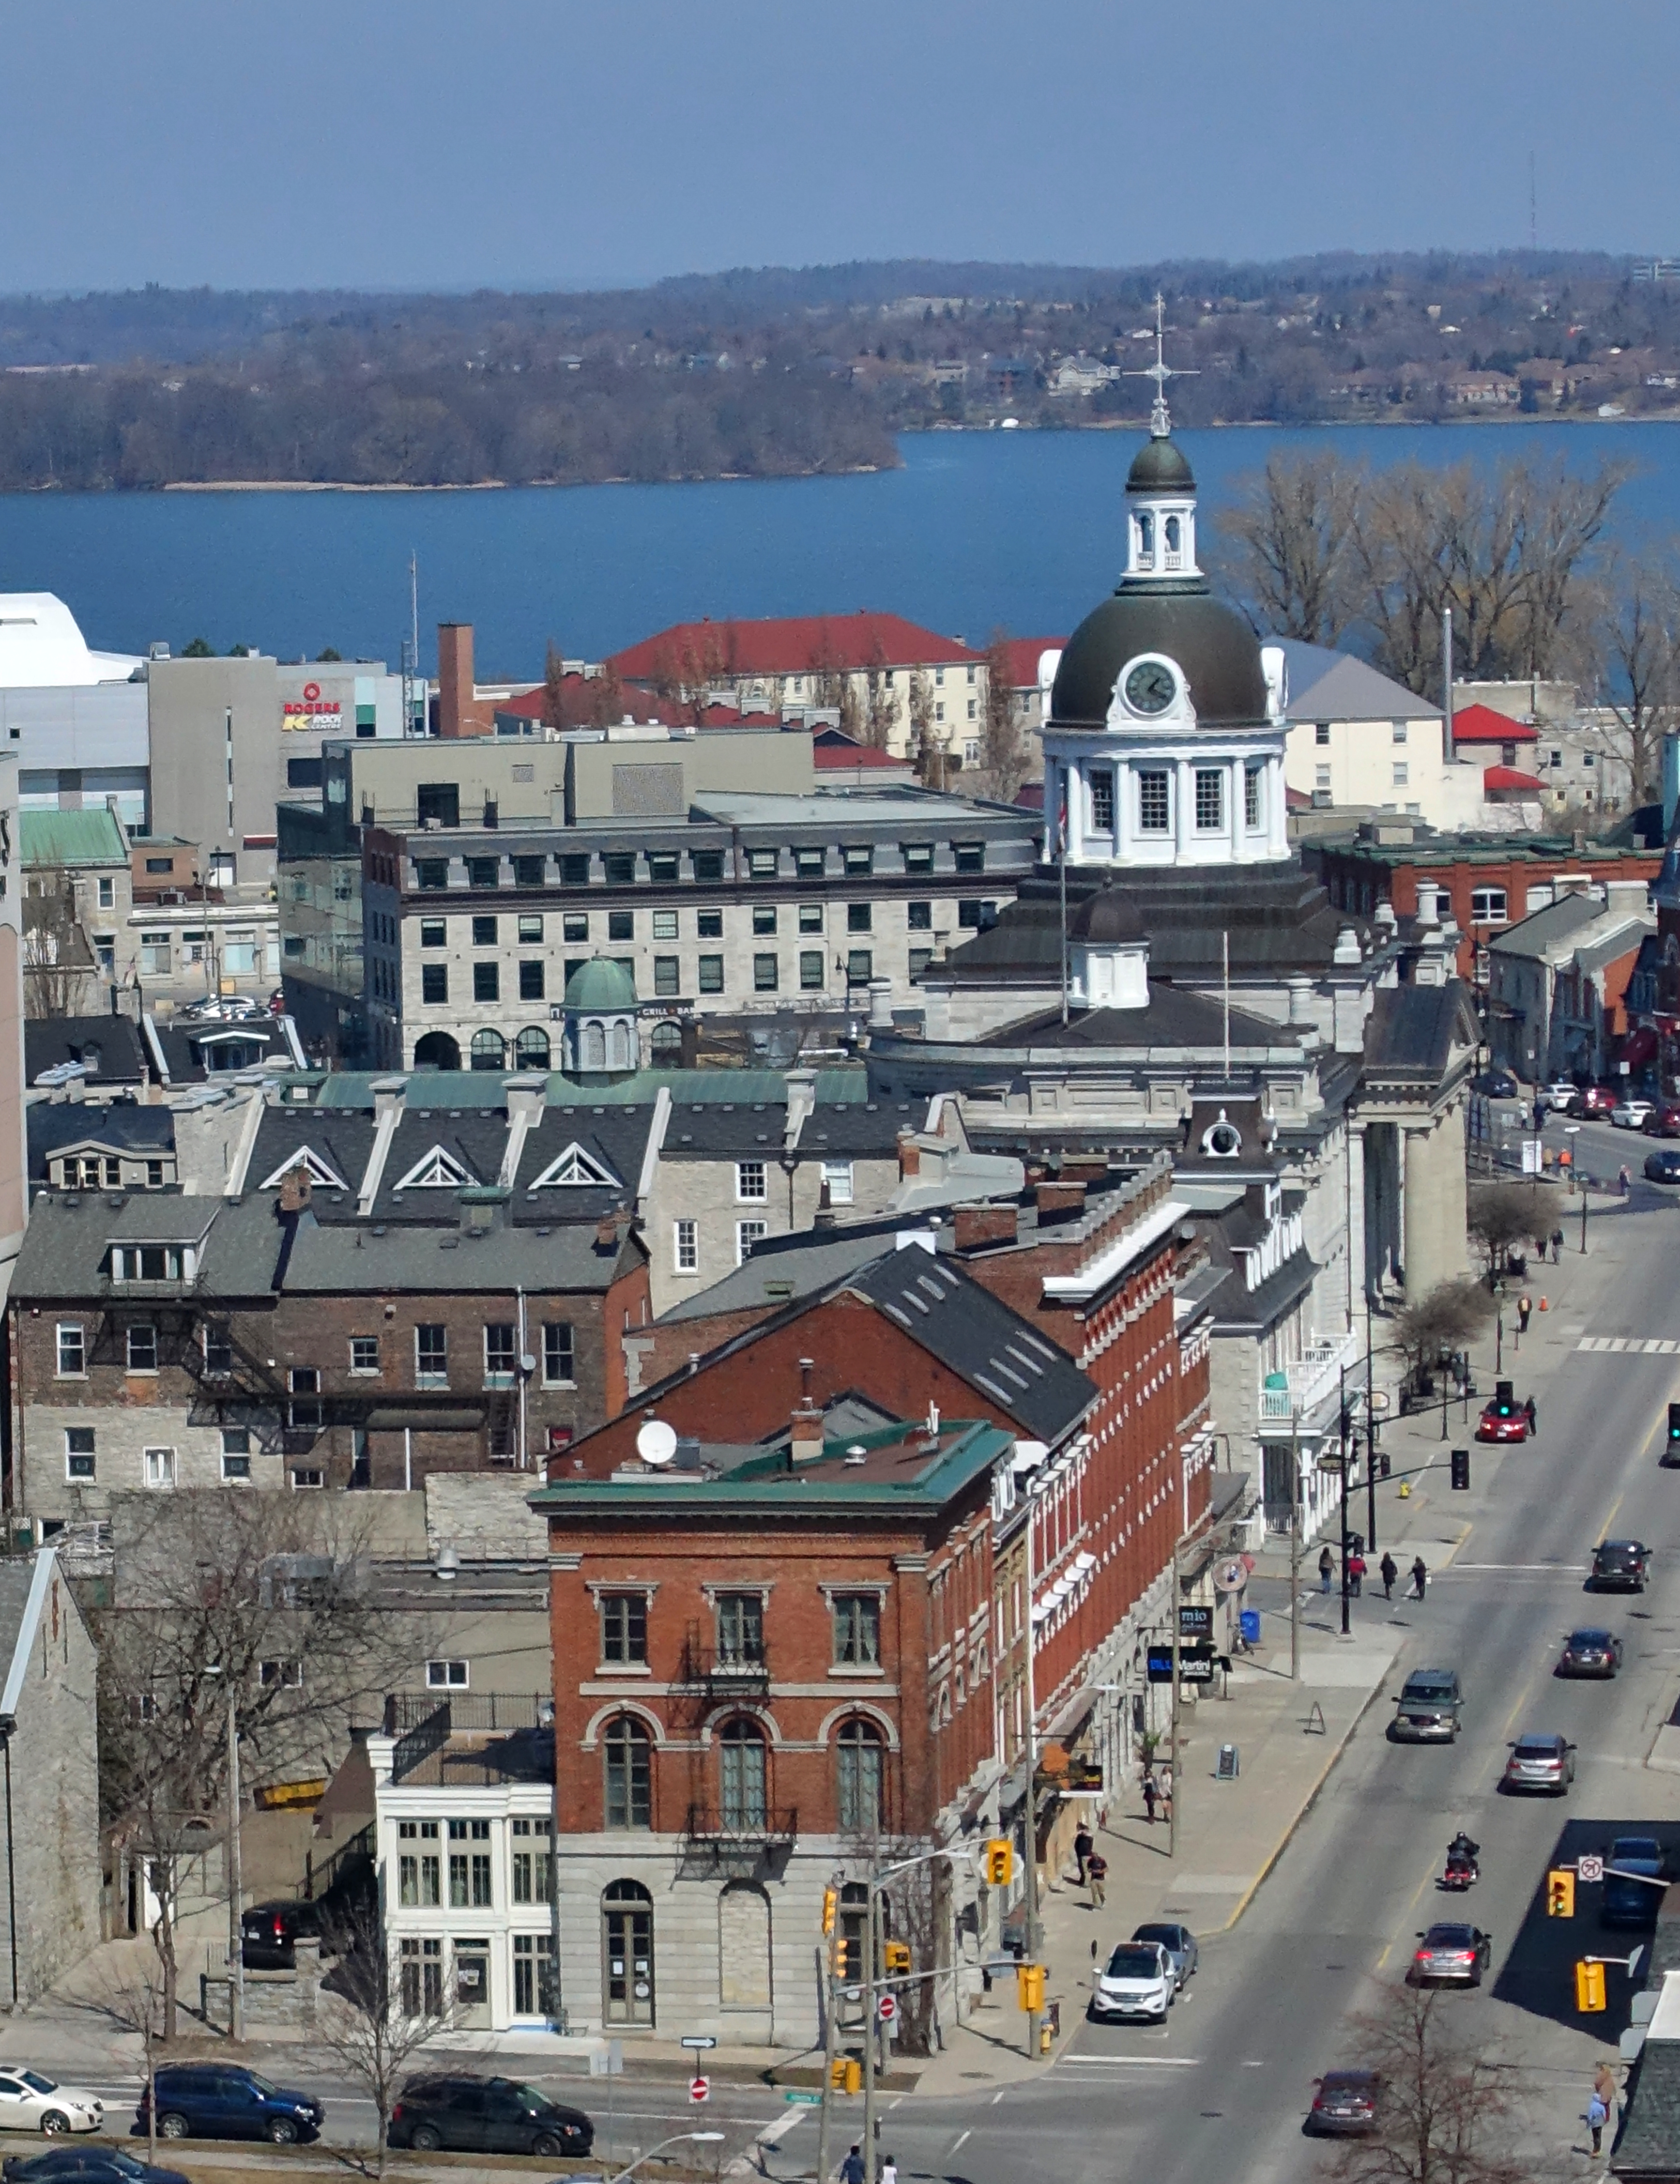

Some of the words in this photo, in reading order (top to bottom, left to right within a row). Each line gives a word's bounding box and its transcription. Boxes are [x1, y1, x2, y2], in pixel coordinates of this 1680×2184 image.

[284, 703, 340, 715] ROGERS
[313, 715, 343, 724] ROCK
[1181, 1609, 1207, 1621] mio
